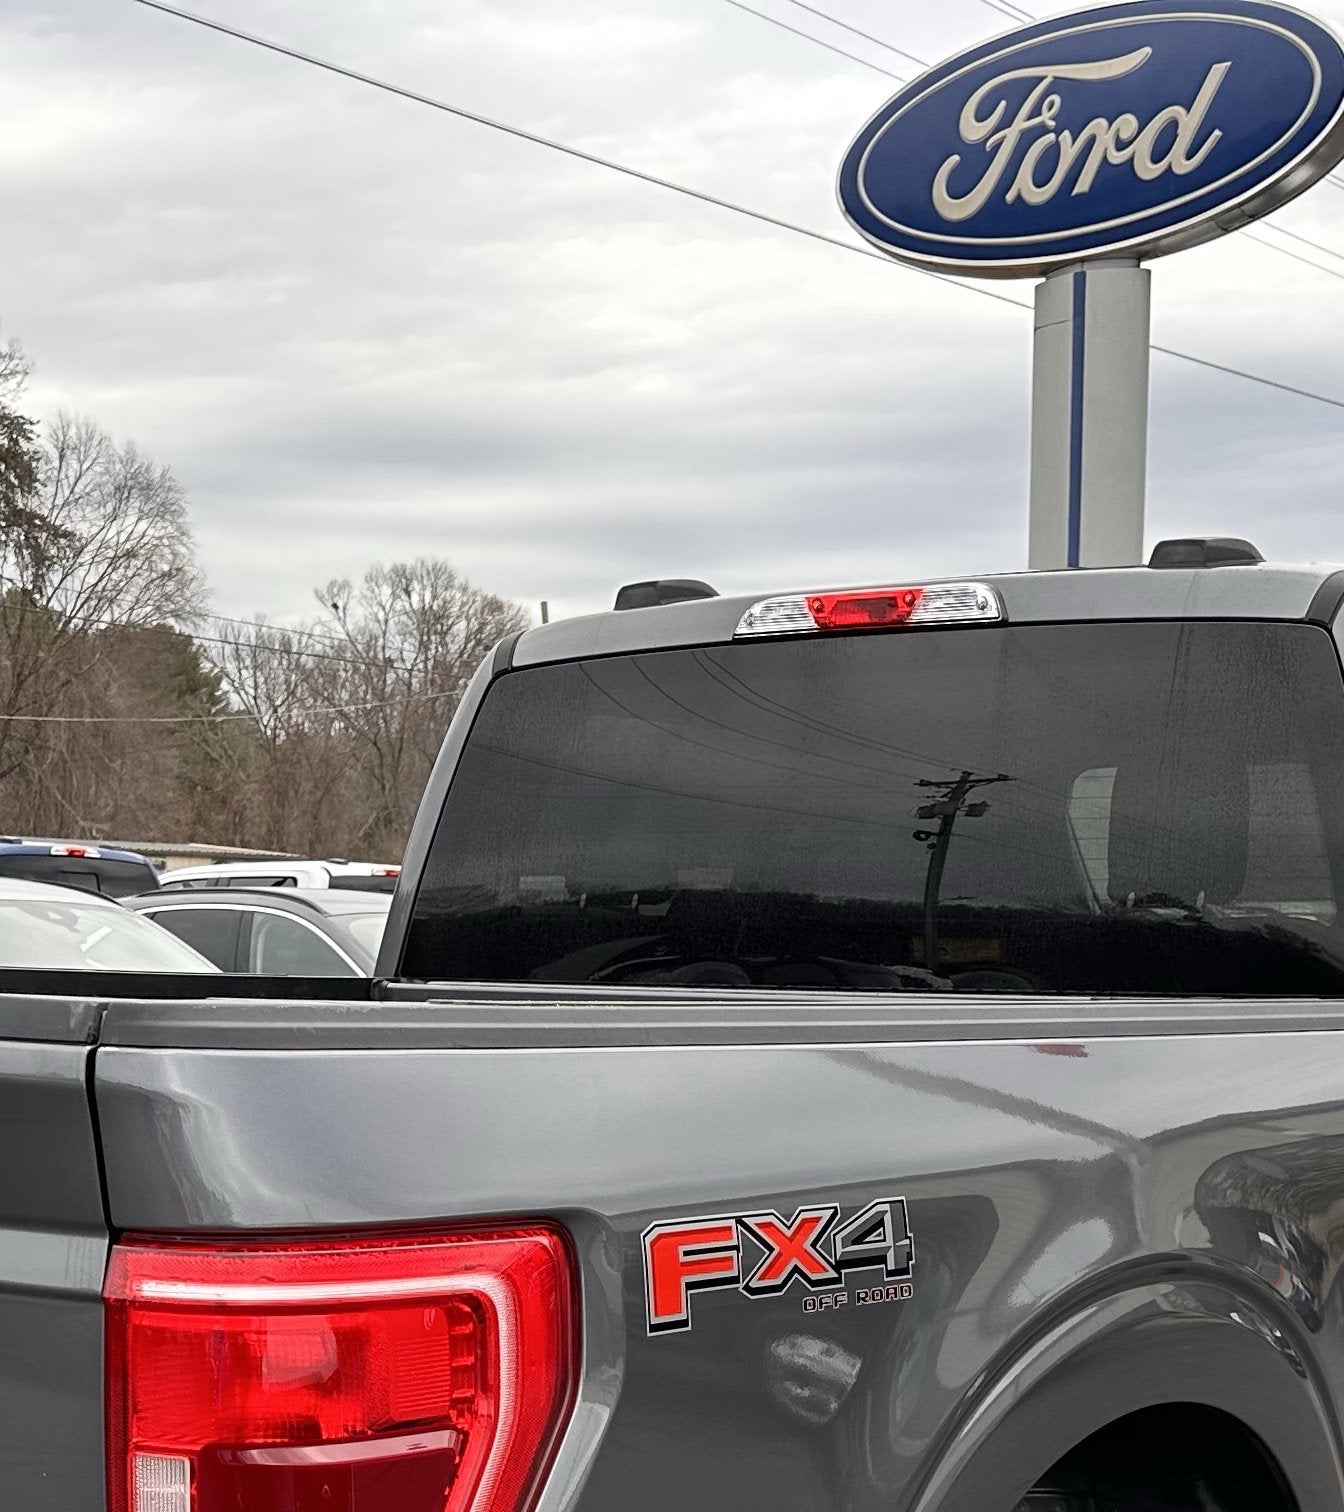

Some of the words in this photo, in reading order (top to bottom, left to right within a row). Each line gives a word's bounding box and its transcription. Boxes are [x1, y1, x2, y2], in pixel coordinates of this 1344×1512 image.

[931, 46, 1232, 221] Ford
[640, 1196, 915, 1337] FX4
[803, 1292, 848, 1313] OFF
[855, 1283, 913, 1306] ROAD
